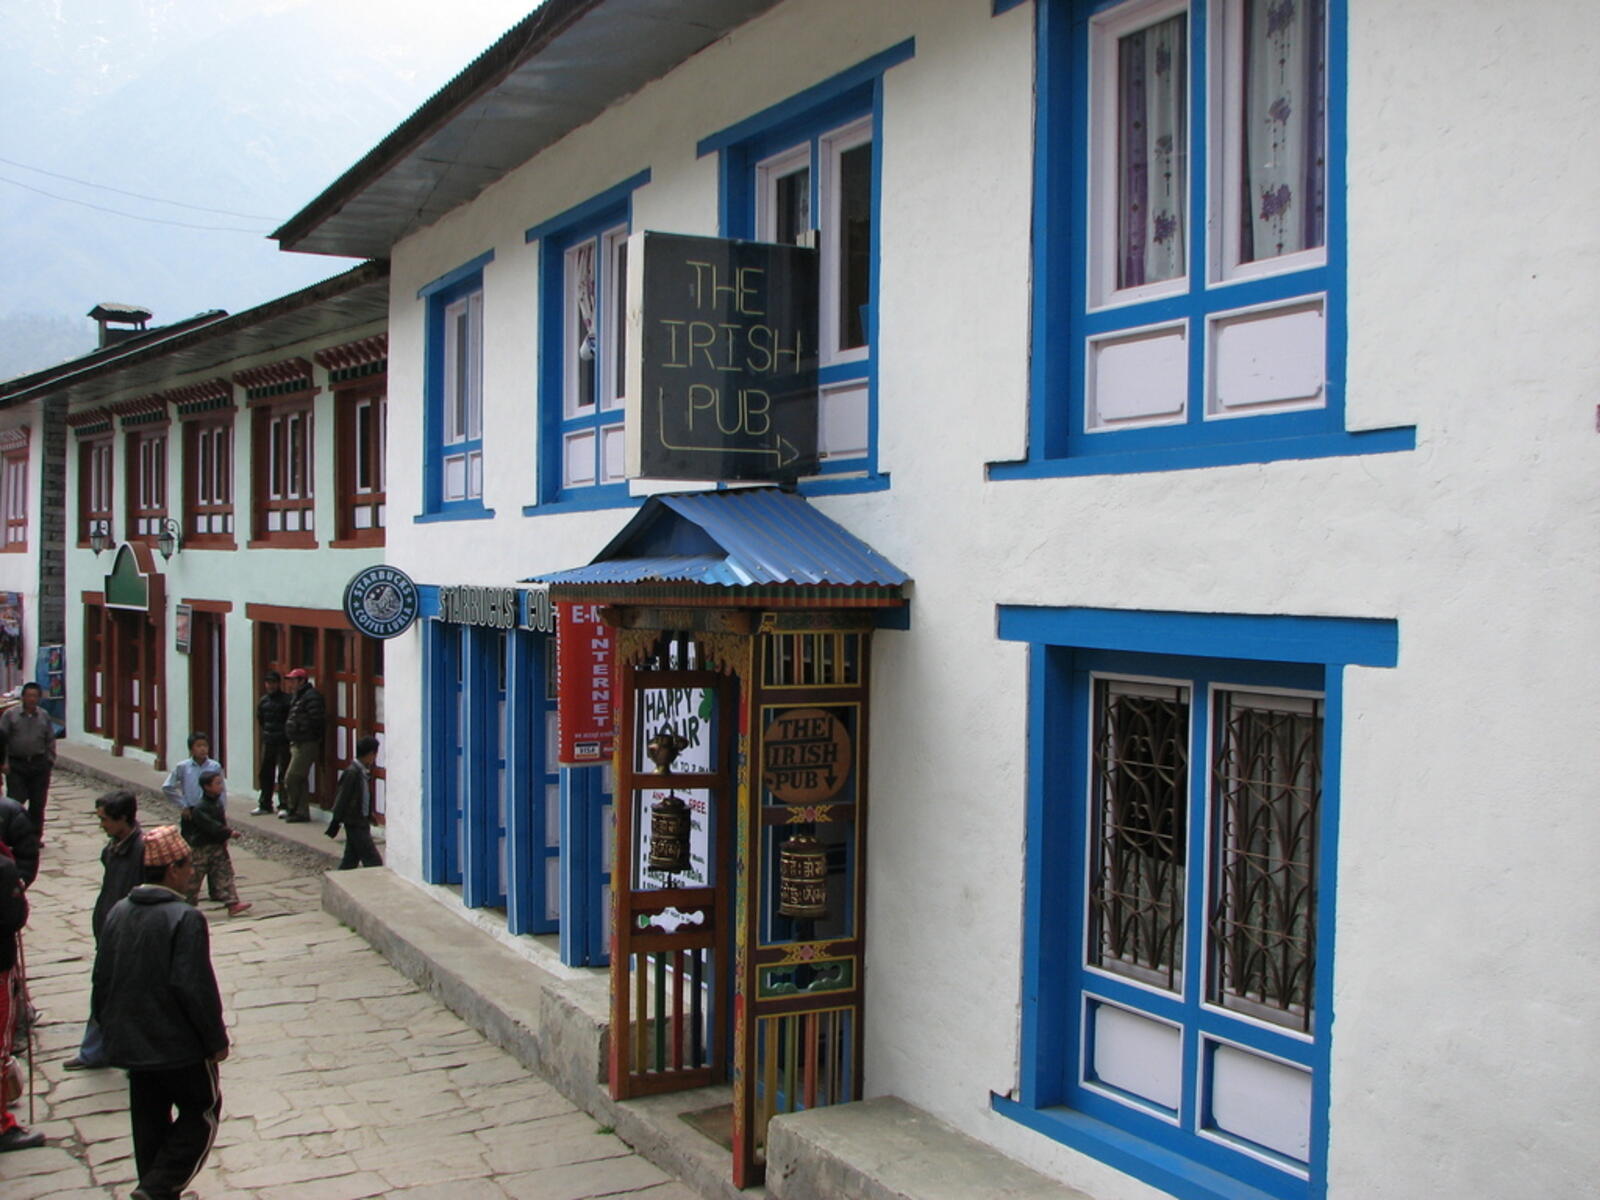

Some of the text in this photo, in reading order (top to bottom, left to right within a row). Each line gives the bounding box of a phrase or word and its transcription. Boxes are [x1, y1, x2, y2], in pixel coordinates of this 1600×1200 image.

[686, 260, 765, 315] THE
[659, 319, 801, 374] IRISH
[689, 384, 771, 435] PUB
[353, 570, 412, 598] STARBUCKS
[355, 609, 384, 633] COFFEE
[439, 584, 559, 633] STARBUCKS COF
[592, 625, 610, 727] INTERNET
[646, 688, 693, 723] HAPPY
[778, 717, 827, 738] THE
[768, 742, 838, 767] IRISH
[775, 770, 819, 791] PUB
